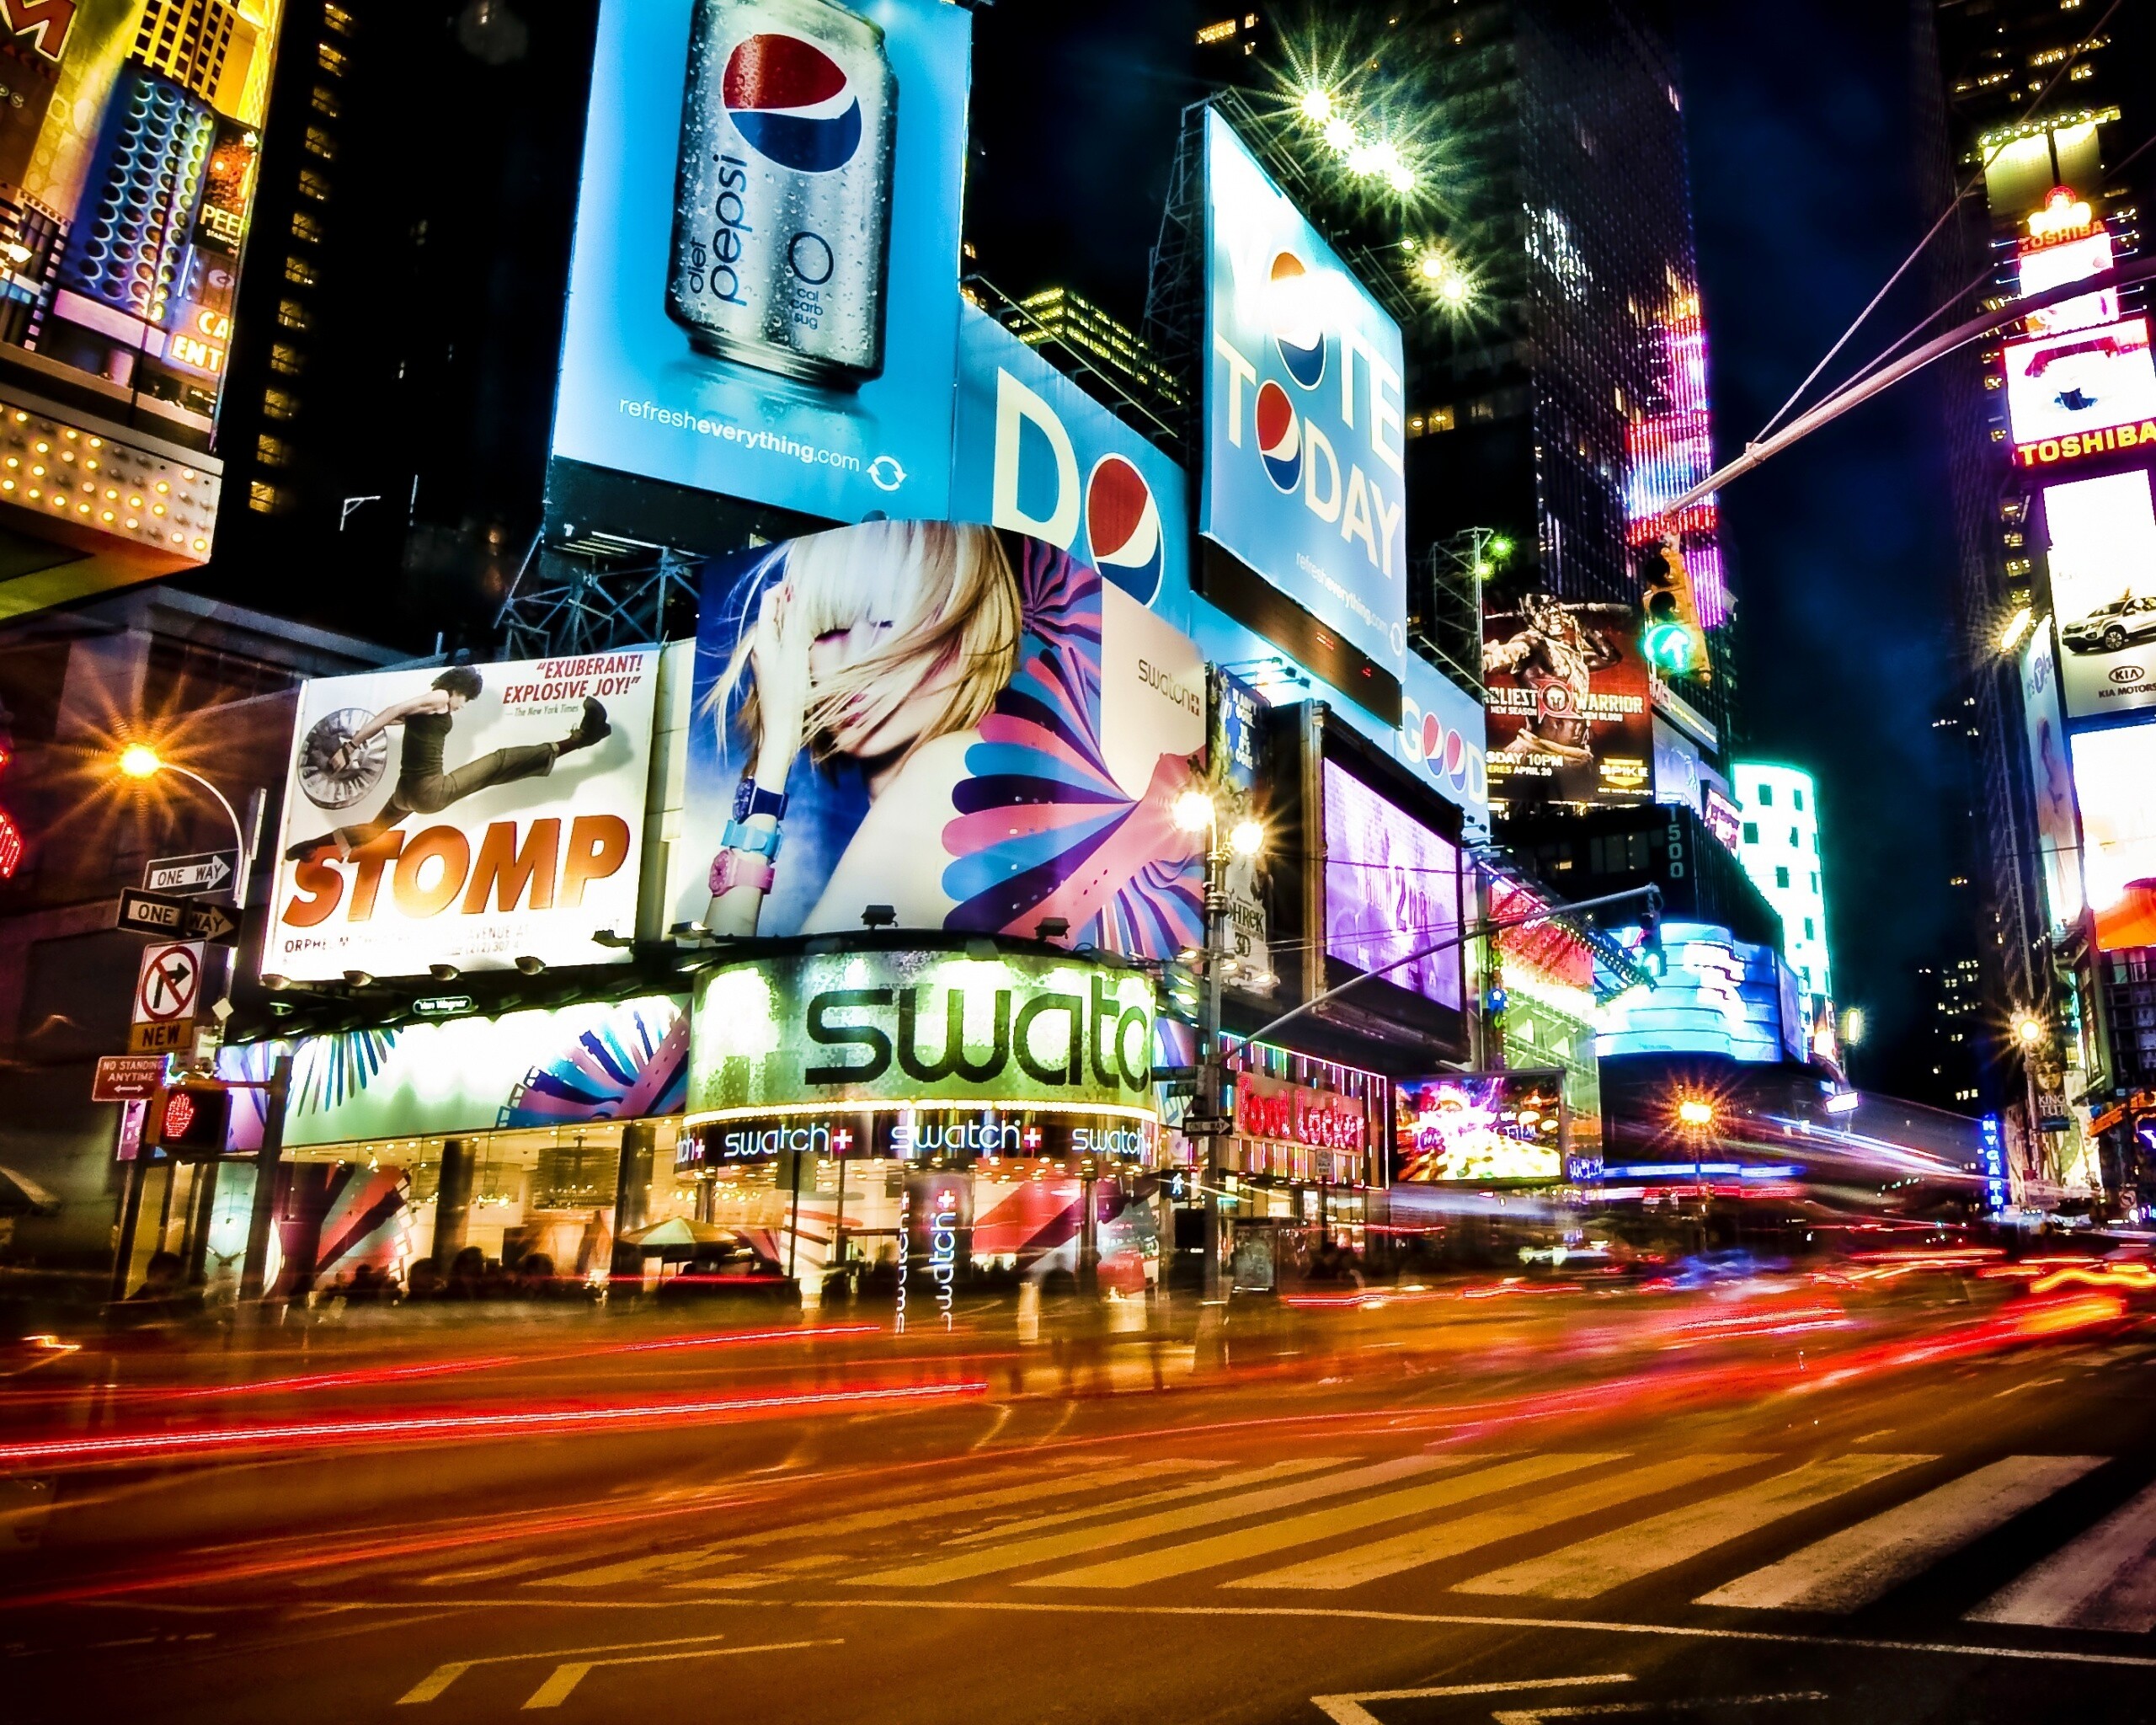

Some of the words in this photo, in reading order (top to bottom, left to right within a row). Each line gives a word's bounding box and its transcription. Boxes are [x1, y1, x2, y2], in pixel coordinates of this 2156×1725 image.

[710, 154, 753, 307] pepsi
[2018, 220, 2106, 251] TOSHIBA
[687, 237, 707, 294] diet
[797, 287, 819, 302] cal
[790, 299, 824, 316] carb
[793, 312, 819, 330] sug
[619, 397, 860, 473] refresheverything.com
[2018, 420, 2156, 467] TOSHIBA
[1295, 552, 1388, 638] refresheverything.com
[536, 654, 643, 679] “EXUBERANT!
[2114, 669, 2140, 680] KIA
[503, 680, 589, 704] EXPLOSIVE
[593, 676, 642, 697] JOY!”
[1138, 659, 1191, 711] swatch
[2099, 689, 2116, 698] KIA
[527, 706, 542, 715] New
[544, 703, 558, 714] York
[560, 703, 579, 714] Times
[1491, 706, 1507, 714] NEW
[1508, 707, 1538, 716] SEASON
[1574, 692, 1643, 713] WARRIOR
[1513, 766, 1540, 776] APRIL
[1540, 767, 1553, 776] 20
[1527, 753, 1564, 766] 10PM
[1599, 764, 1649, 777] SPIKE
[1668, 806, 1684, 879] 1500
[157, 870, 184, 886] ONE
[195, 862, 223, 882] WAY
[281, 814, 632, 927] STOMP
[137, 904, 173, 924] ONE
[189, 912, 224, 933] WAY
[1235, 932, 1251, 958] 3D
[142, 1024, 181, 1047] NEW
[103, 1061, 116, 1071] NO
[119, 1060, 164, 1071] STANDING
[108, 1071, 155, 1082] ANYTIME
[2038, 1095, 2066, 1106] KING
[2040, 1105, 2065, 1117] TUT
[1188, 1121, 1203, 1132] ONE
[1210, 1119, 1230, 1131] WAY
[1295, 1090, 1365, 1151] Locker
[724, 1123, 830, 1157] swatch
[889, 1119, 1021, 1150] swatch
[1071, 1125, 1146, 1156] swatch
